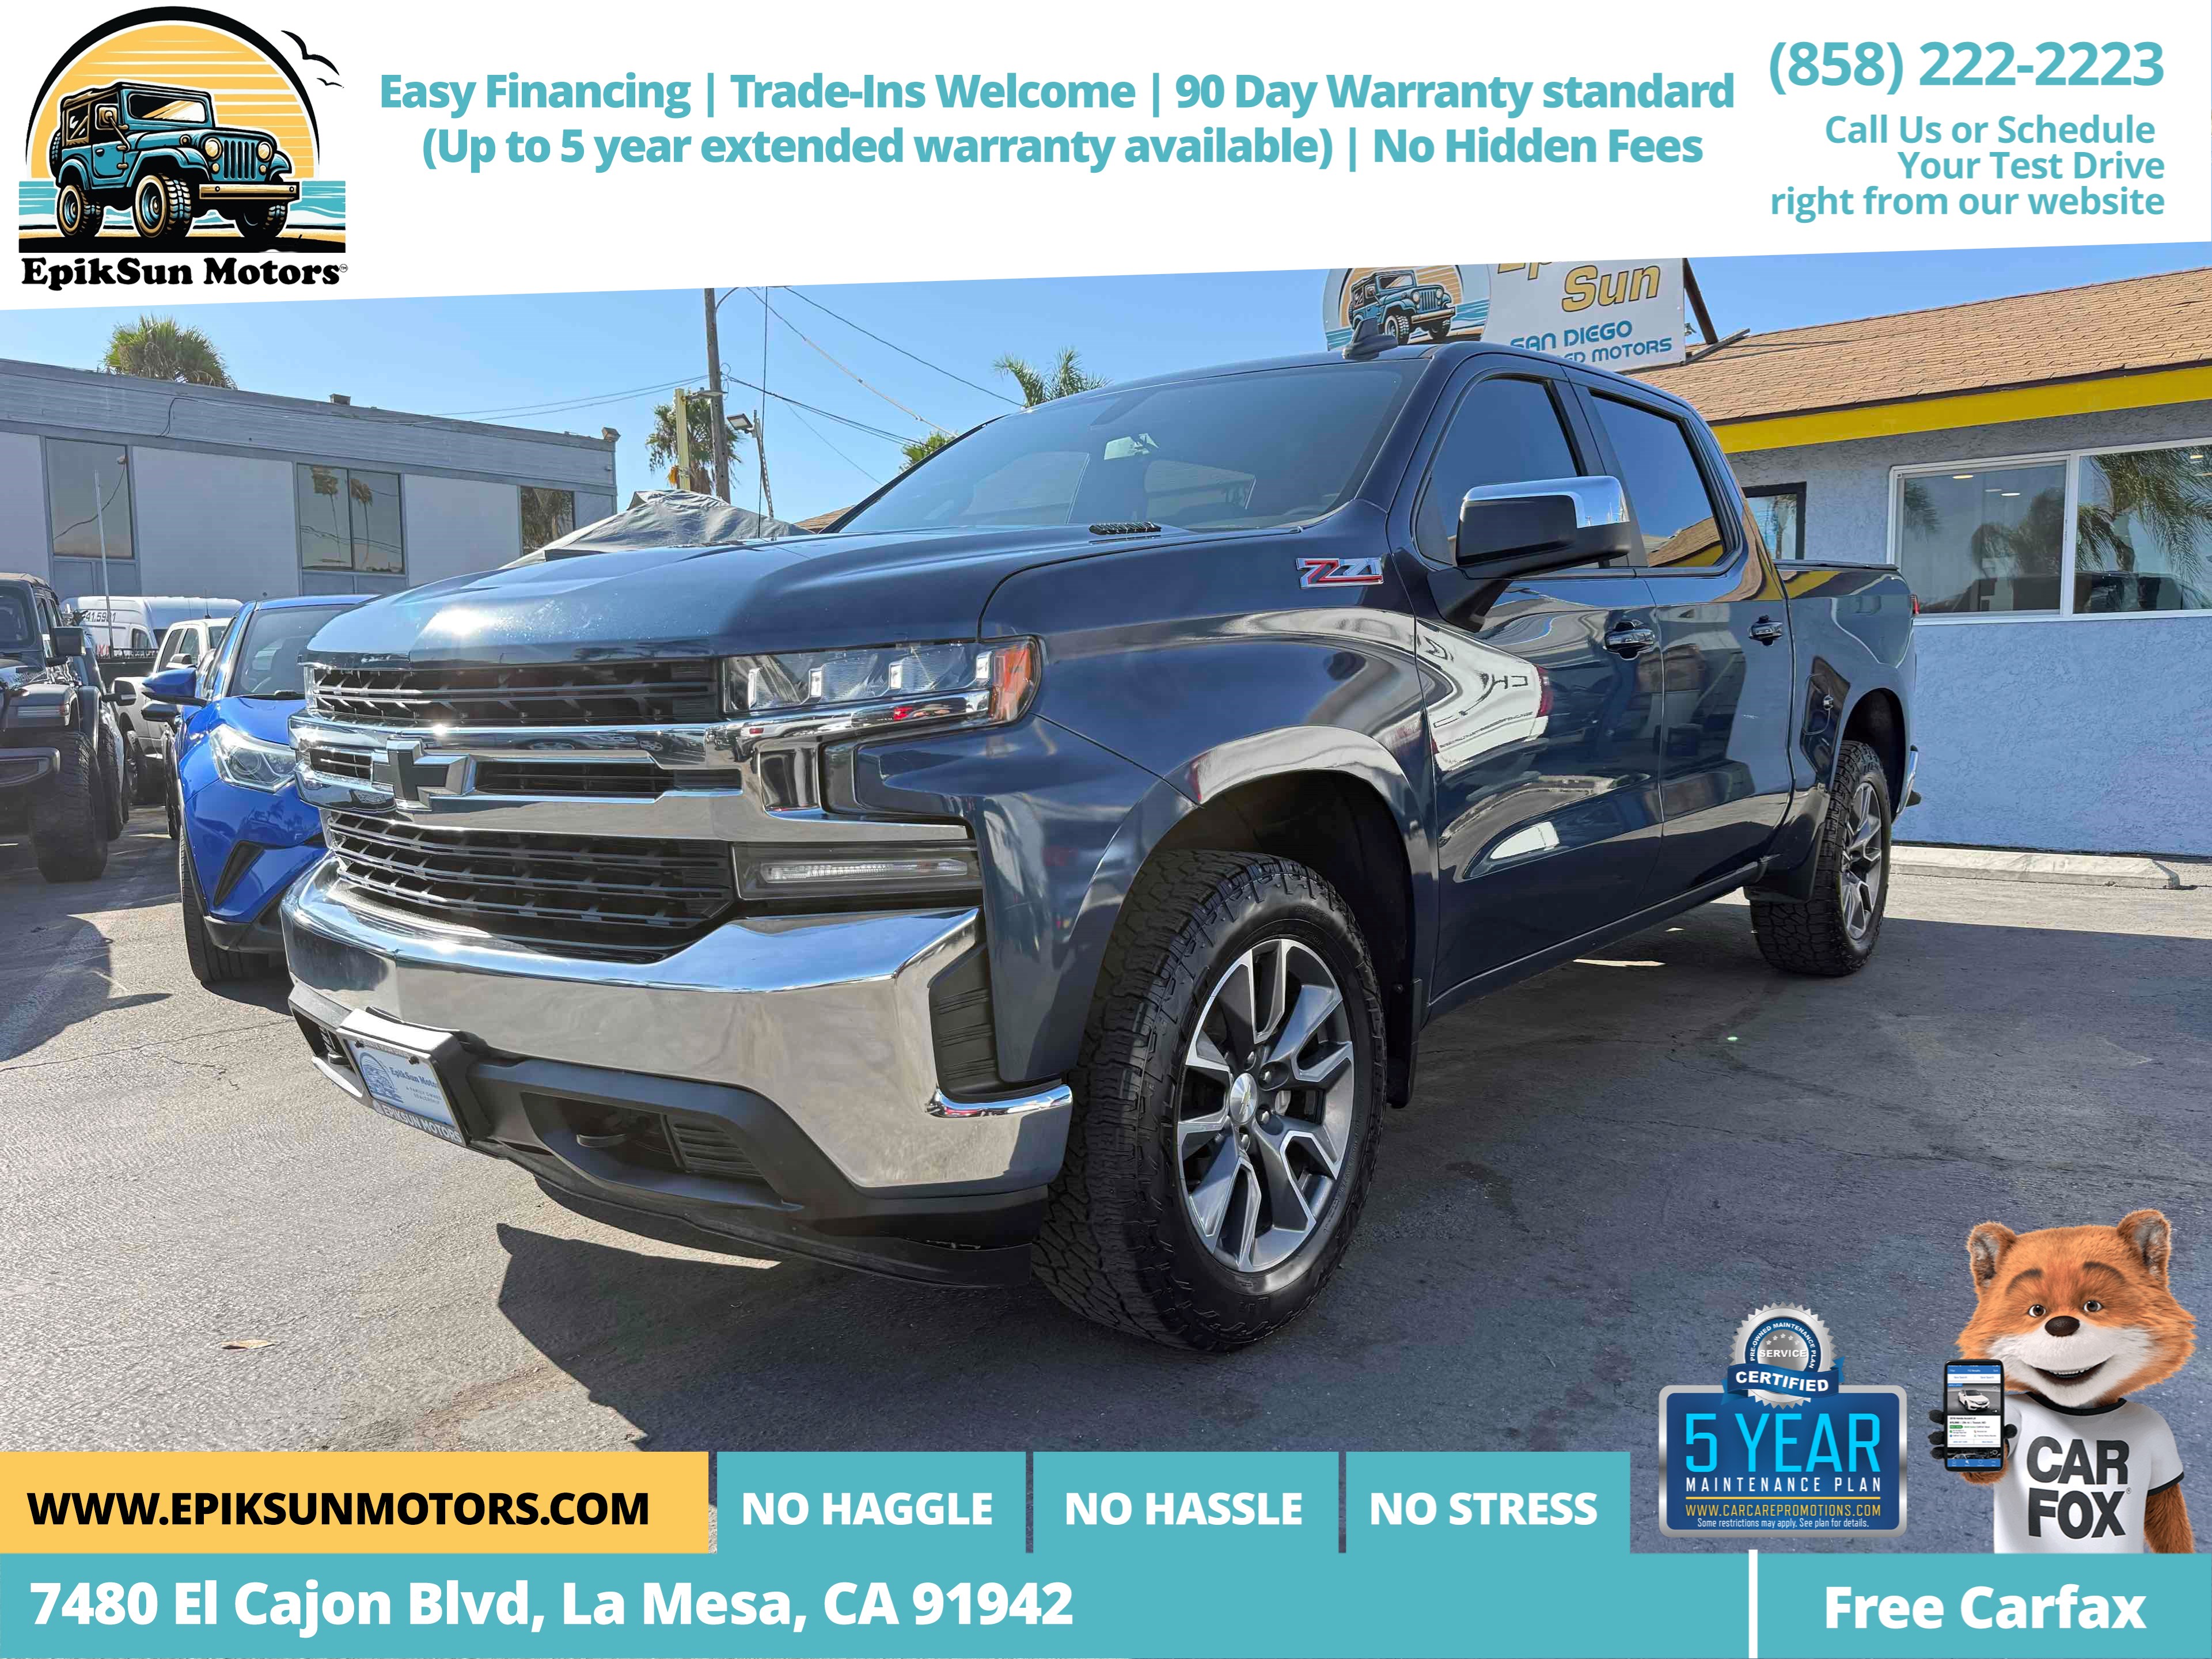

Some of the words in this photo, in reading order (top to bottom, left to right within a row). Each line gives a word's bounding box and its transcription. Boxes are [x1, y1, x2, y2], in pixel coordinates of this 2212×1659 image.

[1562, 265, 1661, 312] Sun
[1564, 320, 1632, 347] DIEGO
[1592, 337, 1672, 362] MOTORS
[1296, 557, 1384, 589] Z71
[383, 1105, 423, 1127] EPIKSUN
[422, 1122, 462, 1142] MOTORS
